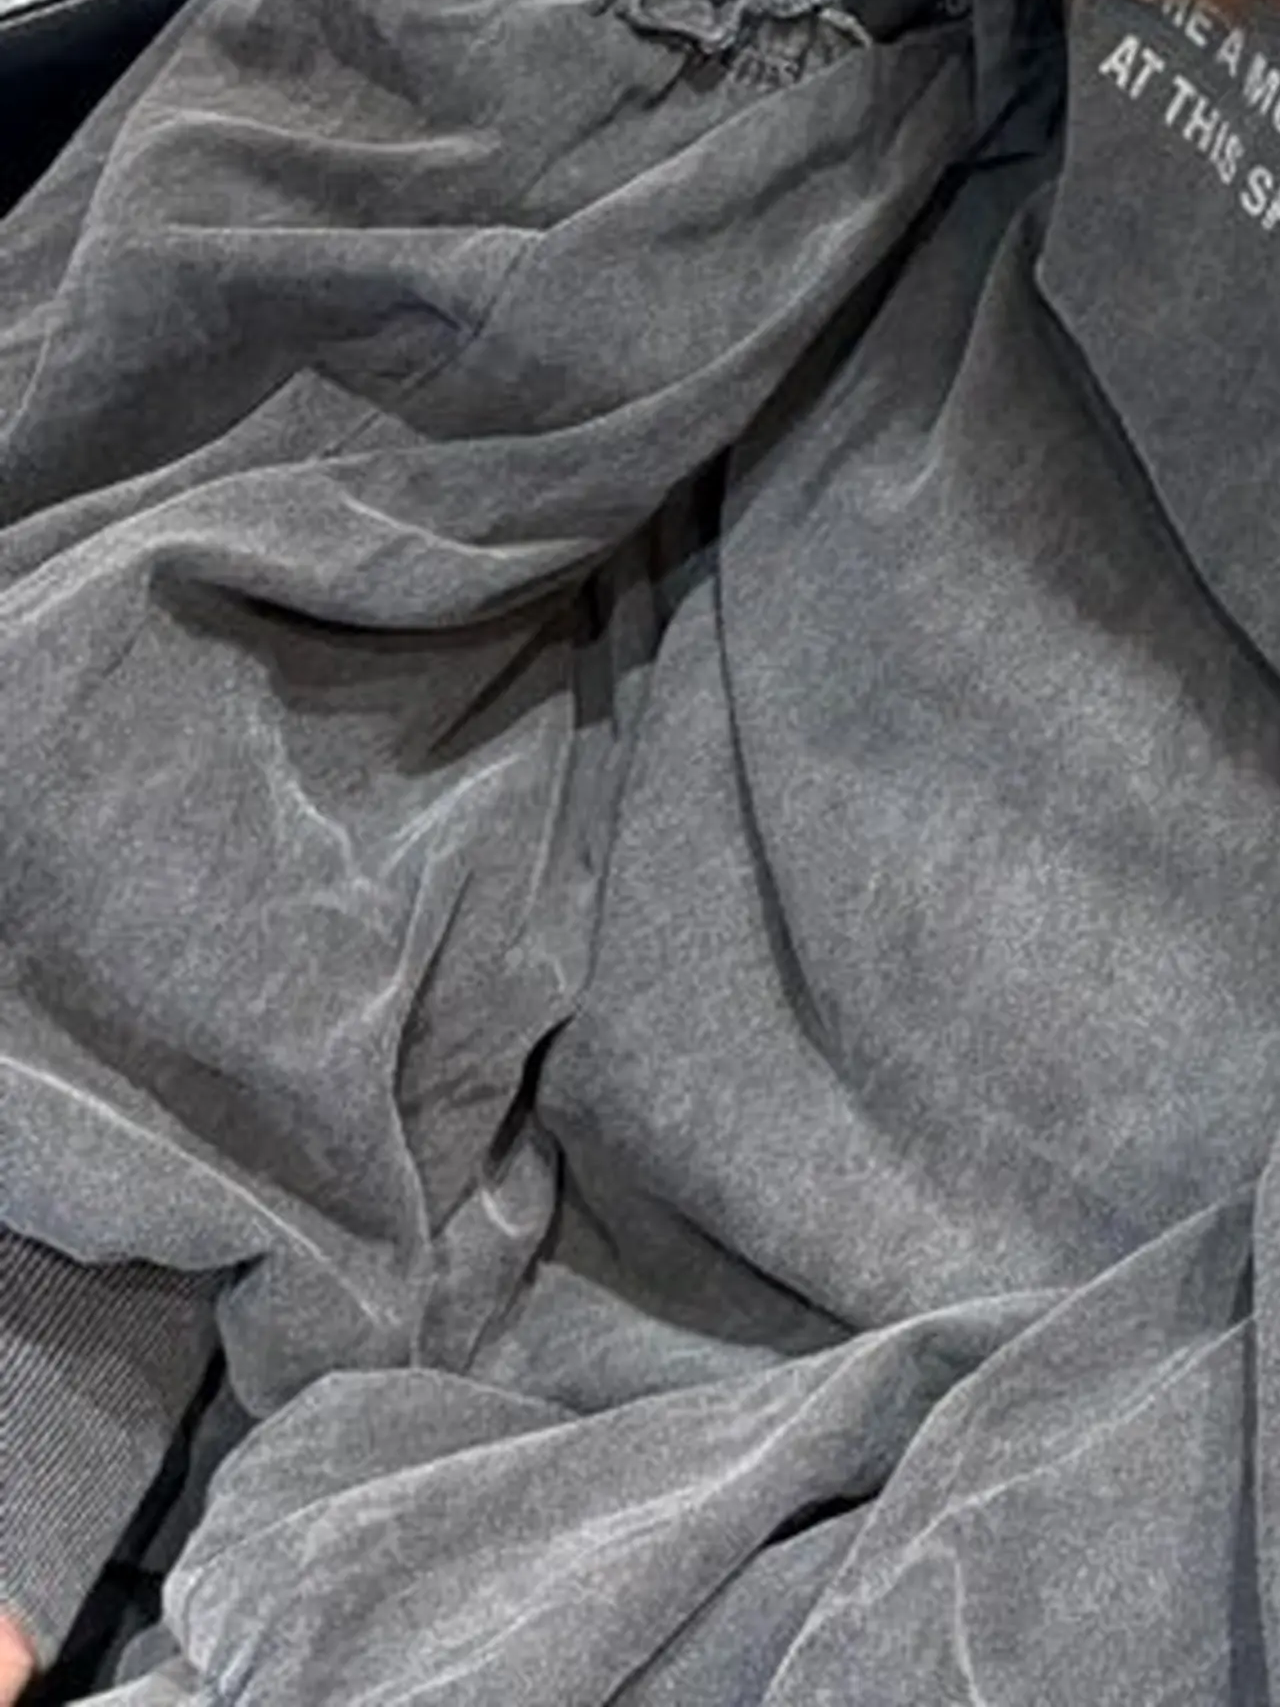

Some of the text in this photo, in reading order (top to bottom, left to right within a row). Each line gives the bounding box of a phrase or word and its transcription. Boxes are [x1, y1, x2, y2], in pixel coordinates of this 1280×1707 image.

[1216, 30, 1246, 78] A
[1099, 34, 1166, 100] AT
[1164, 74, 1244, 184] THIS
